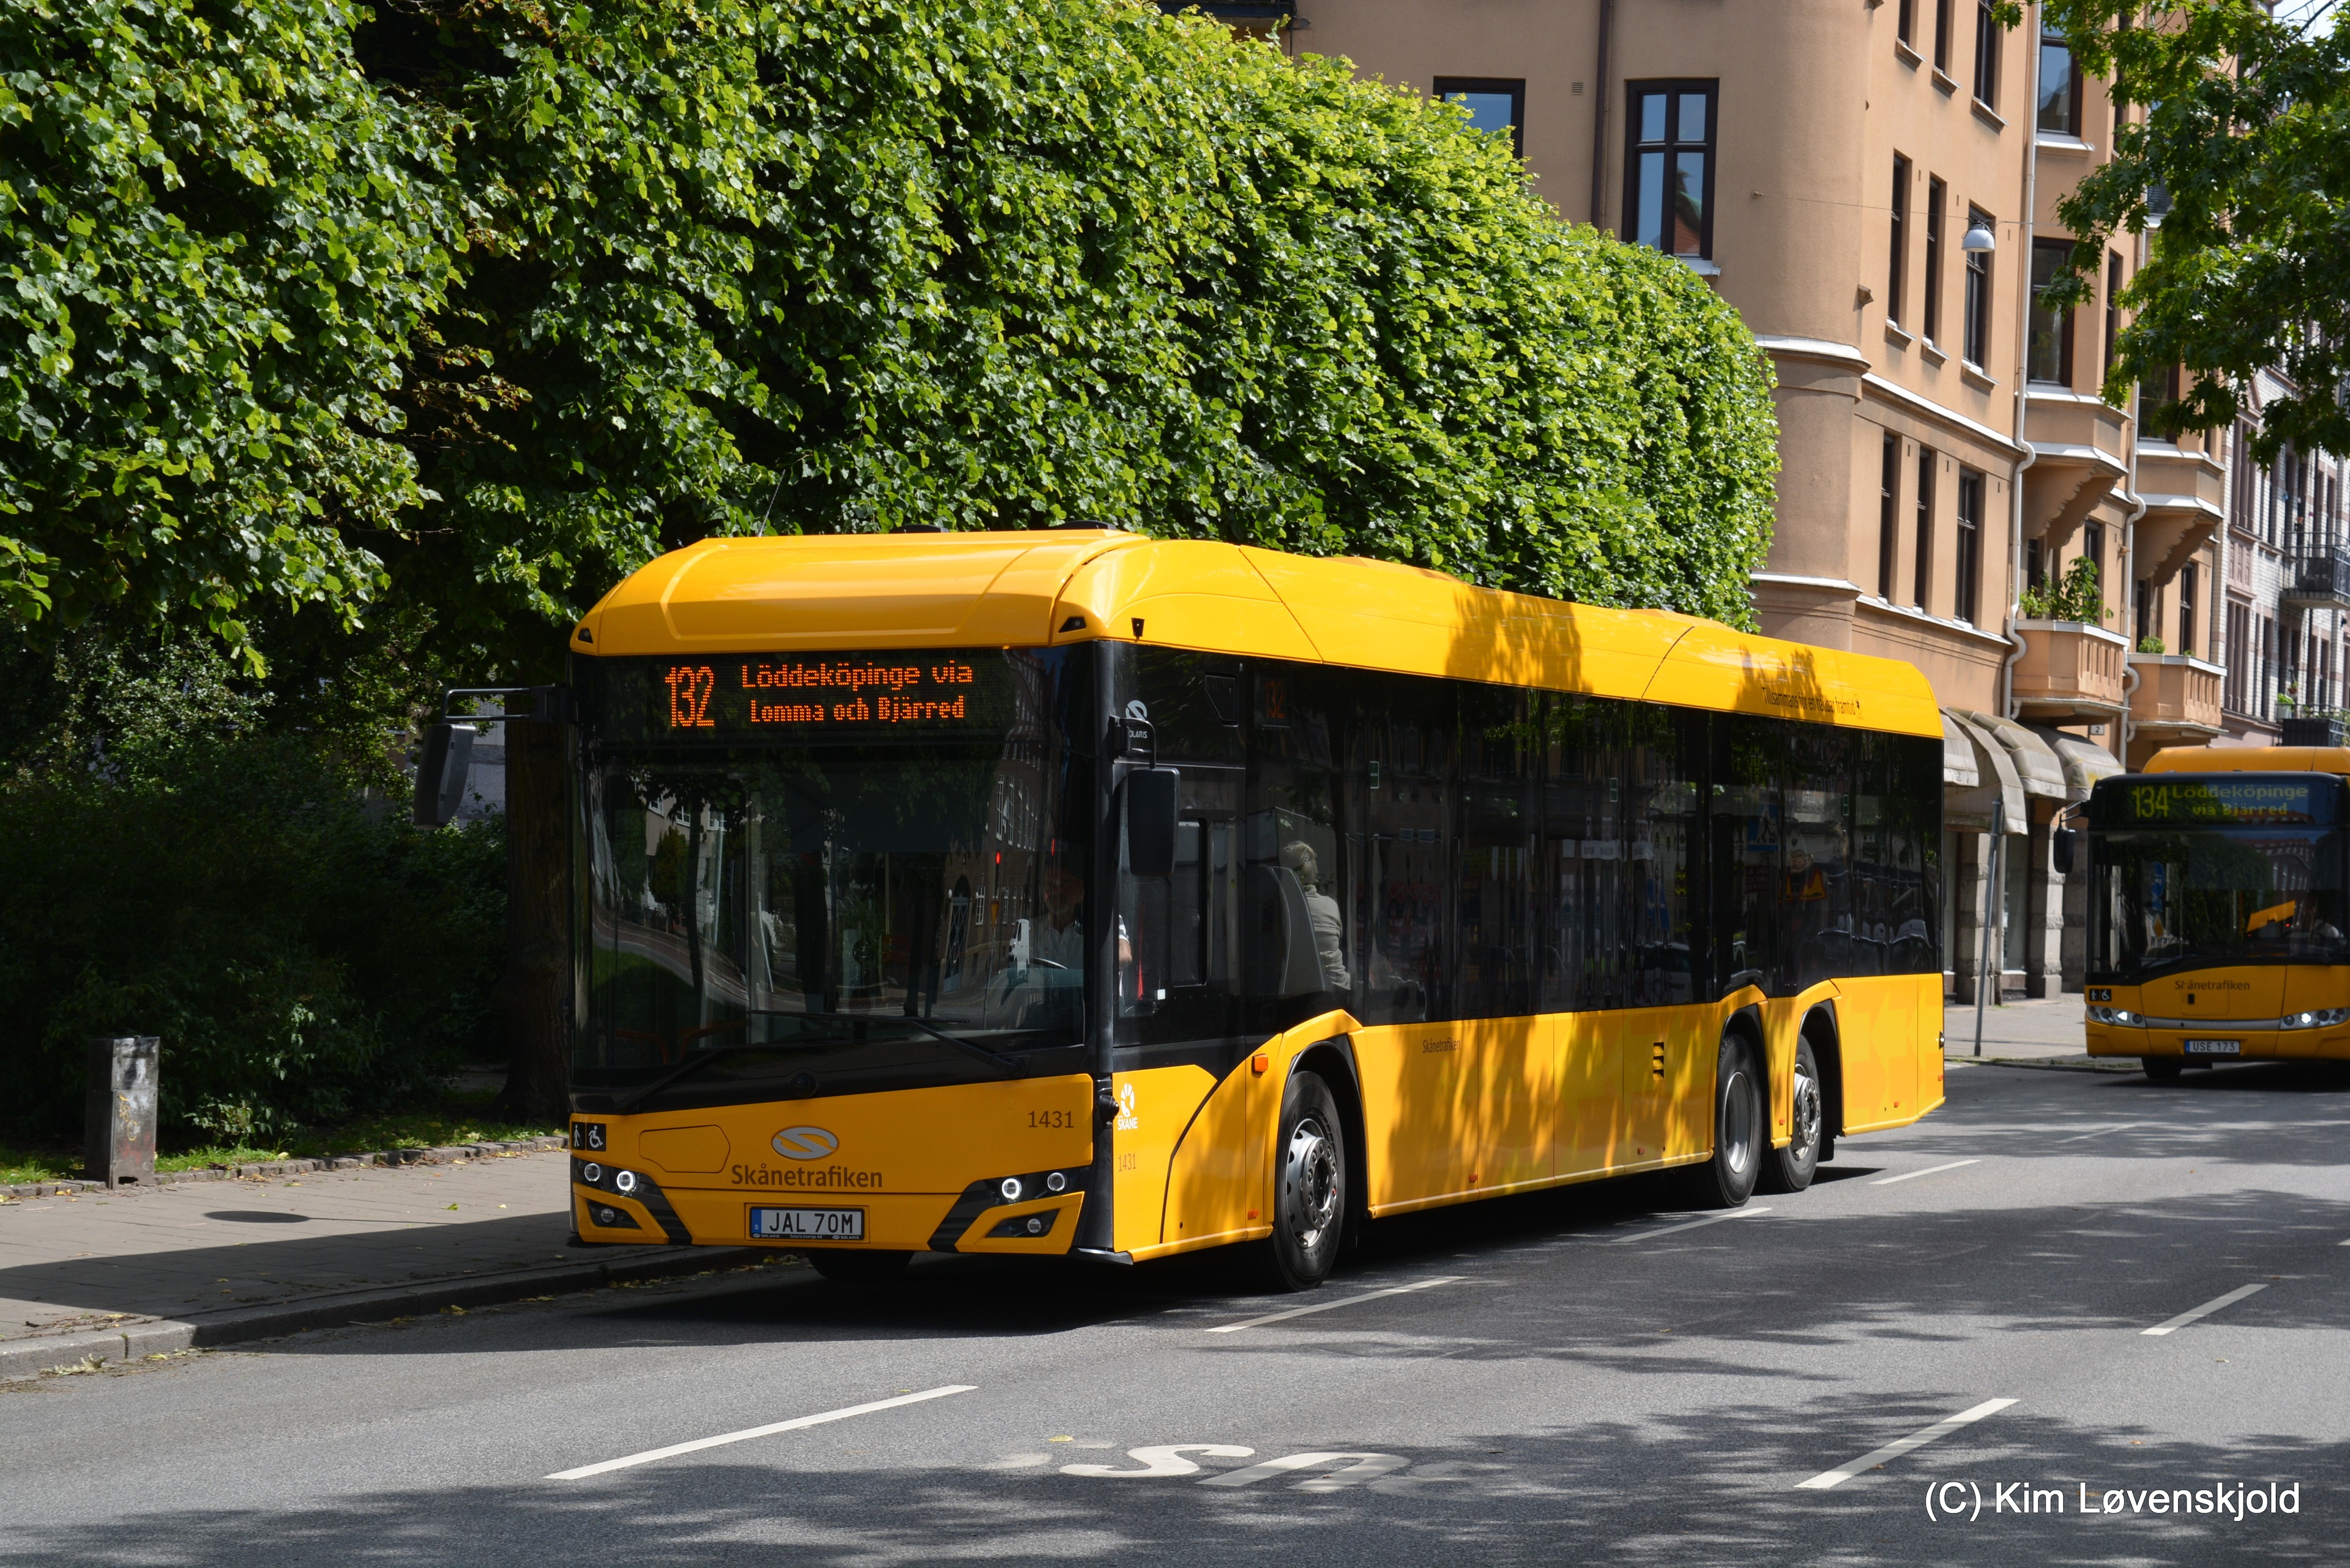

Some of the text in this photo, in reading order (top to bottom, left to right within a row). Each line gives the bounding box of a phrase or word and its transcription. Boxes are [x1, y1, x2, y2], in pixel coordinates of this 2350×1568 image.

[742, 660, 972, 692] Löddeköpinge via
[665, 666, 714, 727] 132
[1761, 687, 1799, 709] Tillsammans
[1798, 692, 1807, 710] för
[1808, 696, 1816, 711] en
[1835, 696, 1856, 715] framtid
[750, 695, 964, 723] Lomma och Bjärred
[1128, 730, 1148, 739] OLARIS
[2131, 786, 2169, 818] 134
[2173, 785, 2309, 801] Löddeköpinge
[2192, 802, 2288, 817] via Bjärred
[1422, 1037, 1461, 1053] Skånetrafiken
[2193, 1042, 2212, 1051] USE
[2217, 1042, 2236, 1051] 173
[1028, 1110, 1074, 1128] 1431
[1118, 1152, 1136, 1171] 1431
[731, 1163, 883, 1188] Skånetrafiken
[769, 1212, 853, 1234] JAL 70M
